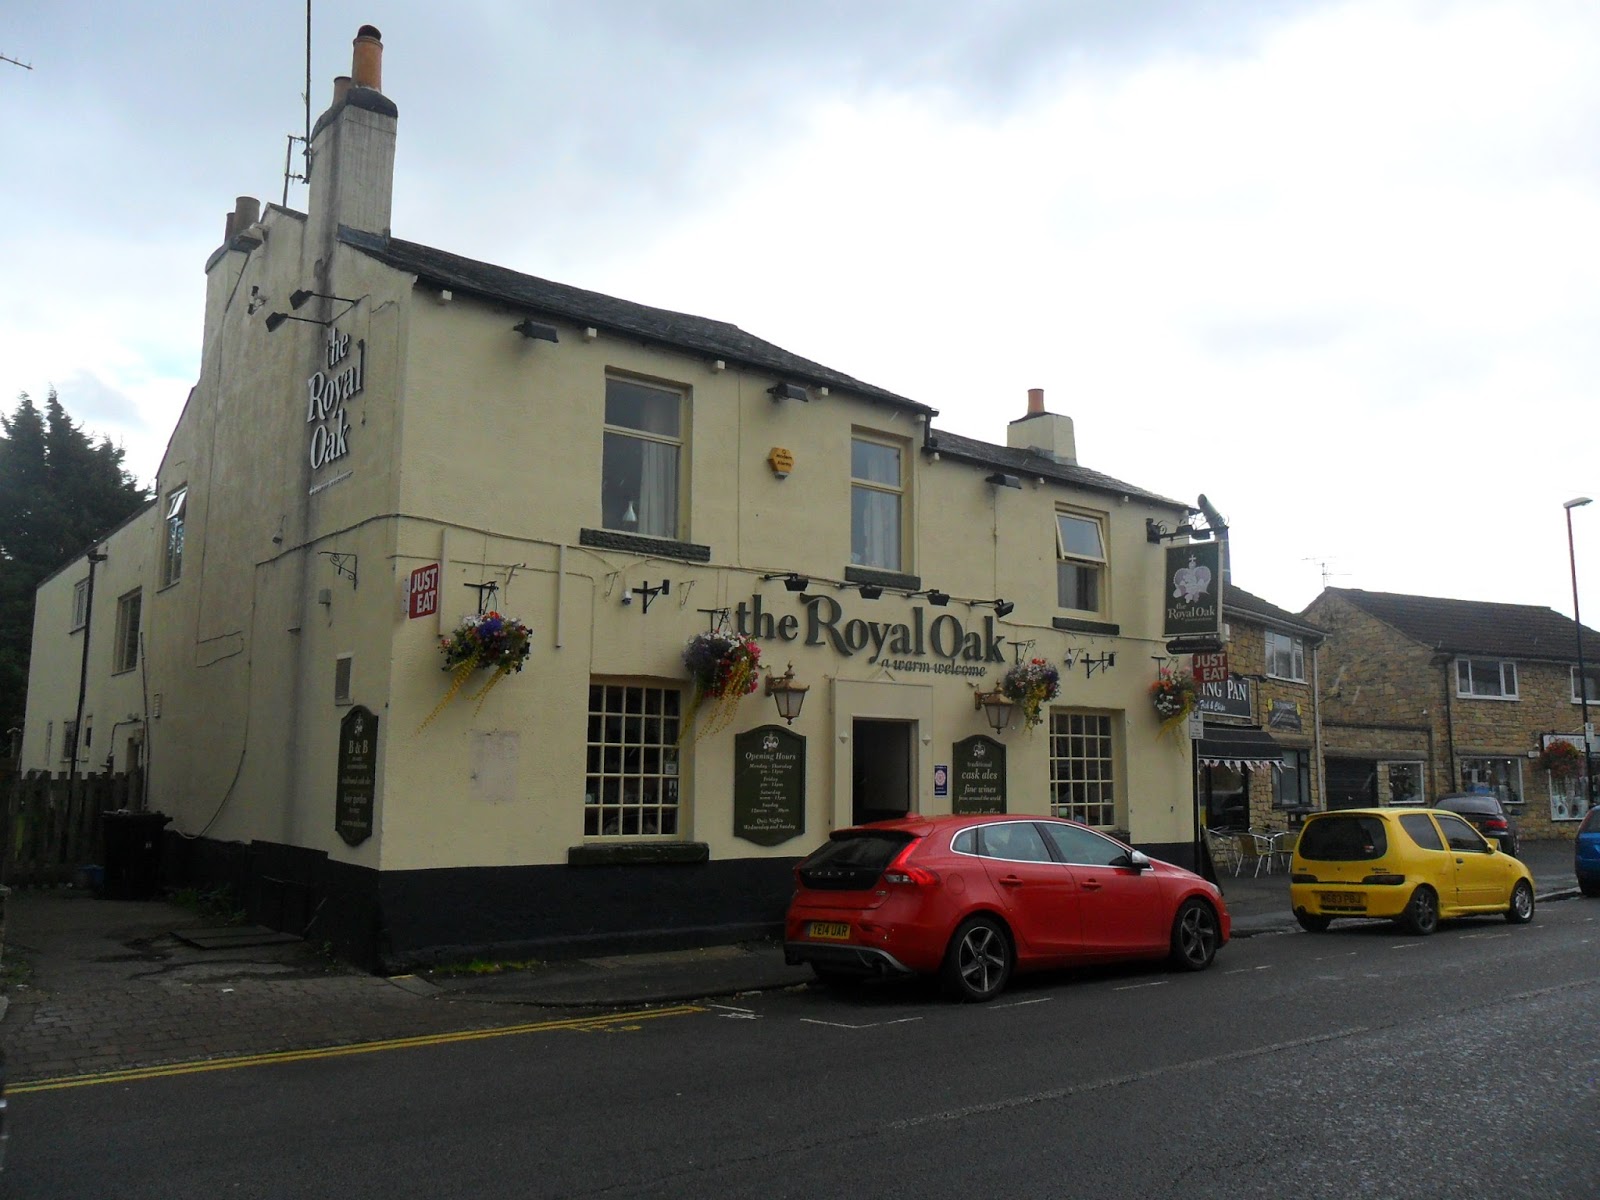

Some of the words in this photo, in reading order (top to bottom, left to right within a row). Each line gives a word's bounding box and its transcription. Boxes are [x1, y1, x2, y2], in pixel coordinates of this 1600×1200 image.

[326, 327, 349, 368] the
[307, 339, 364, 423] Royal
[310, 409, 350, 470] Oak
[412, 568, 437, 593] JUST
[416, 590, 436, 613] EAT
[1167, 607, 1195, 621] Royal
[1195, 605, 1215, 617] Oak
[736, 594, 799, 641] the
[800, 592, 926, 664] Royal
[930, 614, 1005, 664] Oak
[881, 659, 889, 668] a
[892, 659, 930, 674] warm
[933, 659, 986, 678] welcome
[1195, 654, 1225, 668] JUST
[1203, 667, 1226, 681] EAT
[1227, 680, 1247, 701] PAN
[348, 740, 354, 754] B
[362, 740, 369, 754] B
[745, 752, 774, 762] Opening
[775, 752, 796, 760] Hours
[961, 768, 980, 780] cask
[981, 768, 998, 780] ales
[964, 784, 977, 795] fine
[978, 784, 996, 793] wines
[813, 922, 828, 935] YE14
[831, 924, 848, 937] UAR
